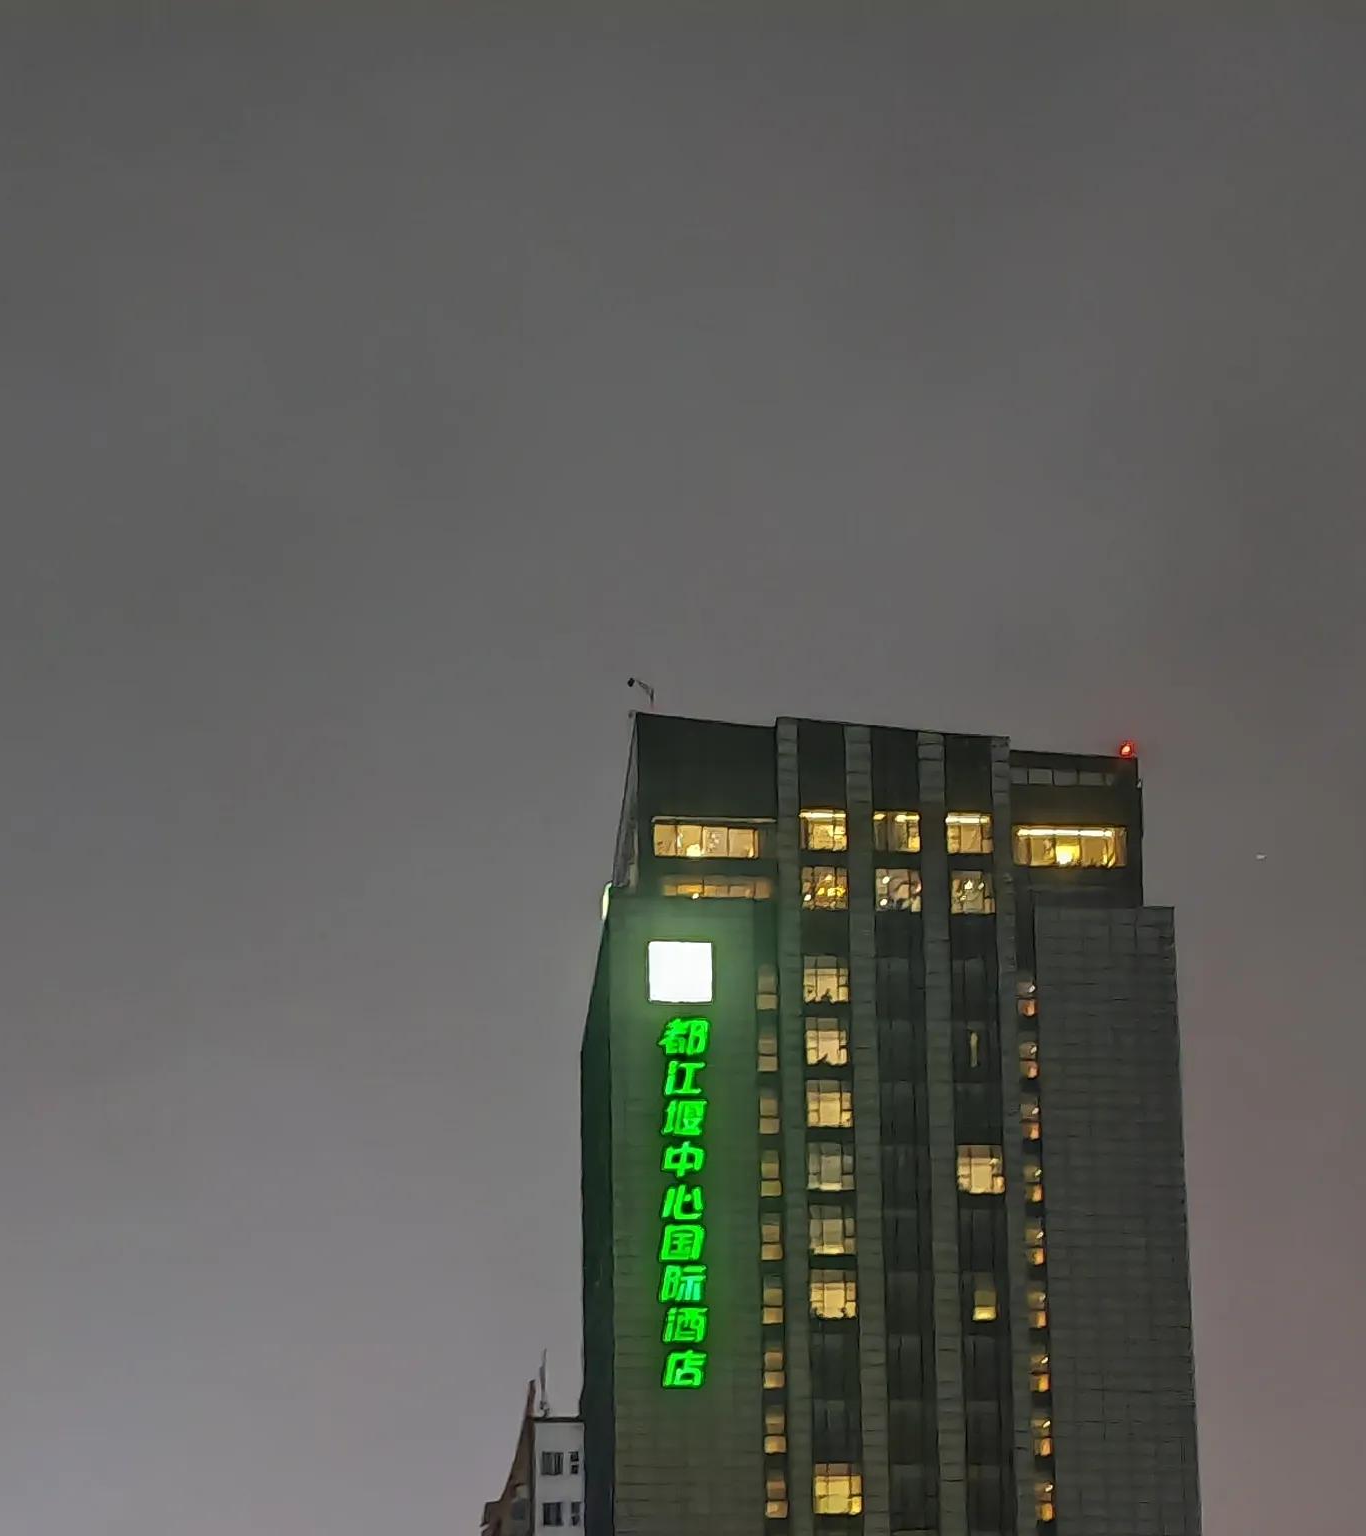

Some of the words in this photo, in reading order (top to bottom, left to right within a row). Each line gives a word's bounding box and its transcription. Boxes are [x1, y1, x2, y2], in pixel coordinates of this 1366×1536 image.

[659, 1018, 709, 1386] 都江堰中心国际酒店
